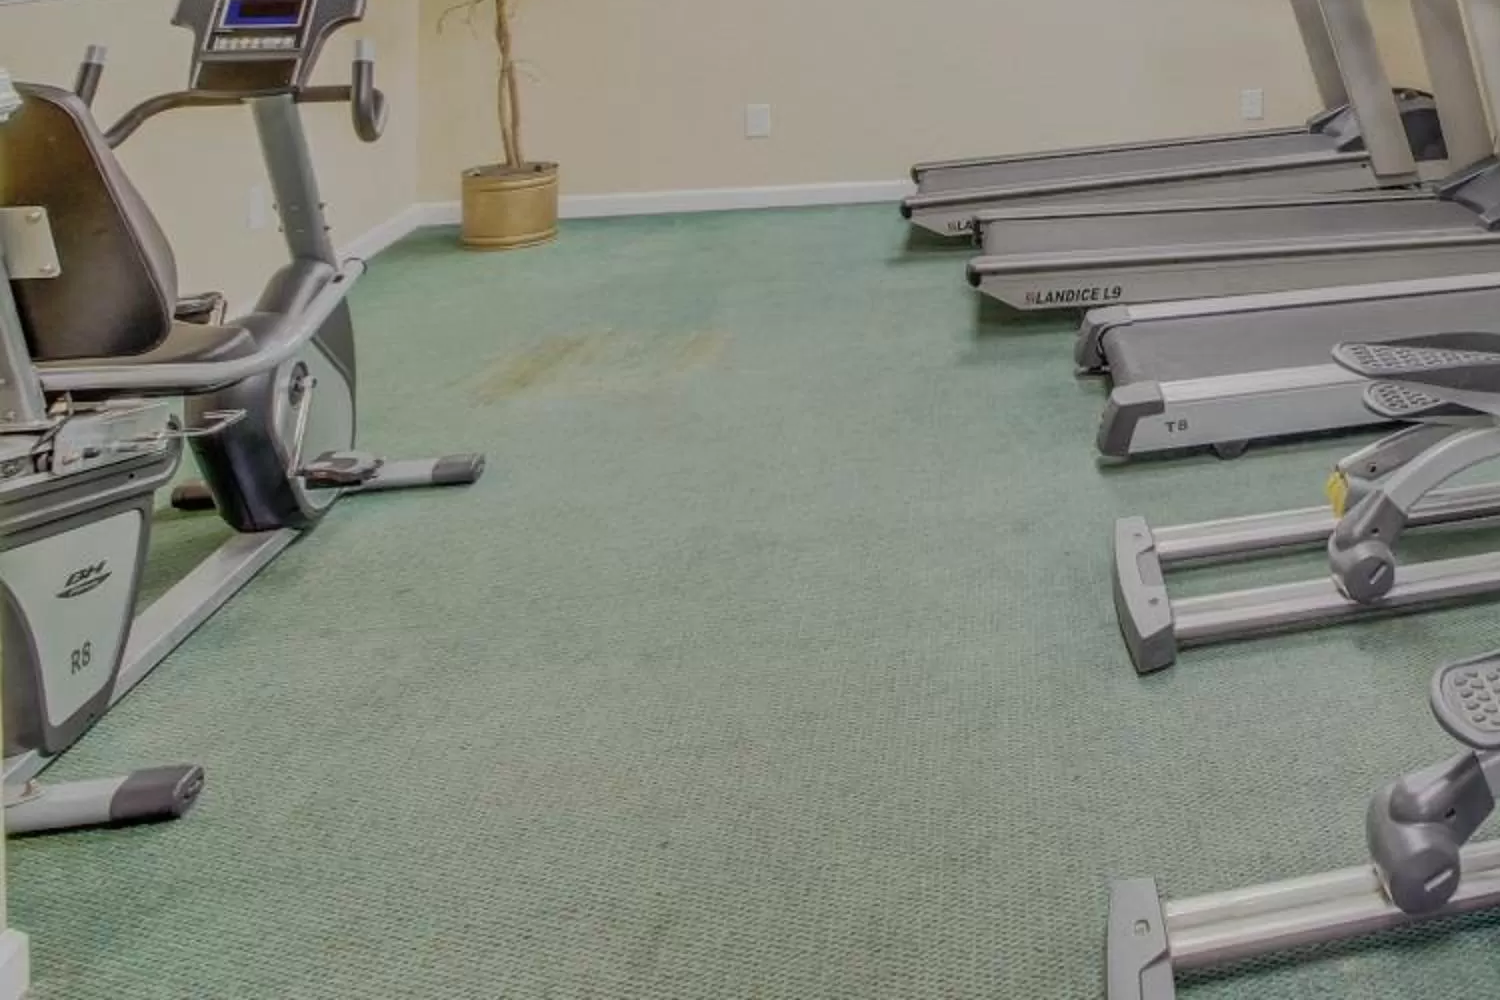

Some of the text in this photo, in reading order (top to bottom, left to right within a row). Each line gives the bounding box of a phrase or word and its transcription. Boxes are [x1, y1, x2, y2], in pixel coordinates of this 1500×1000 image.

[1035, 284, 1123, 304] LANDICE L9
[70, 640, 92, 675] R8
